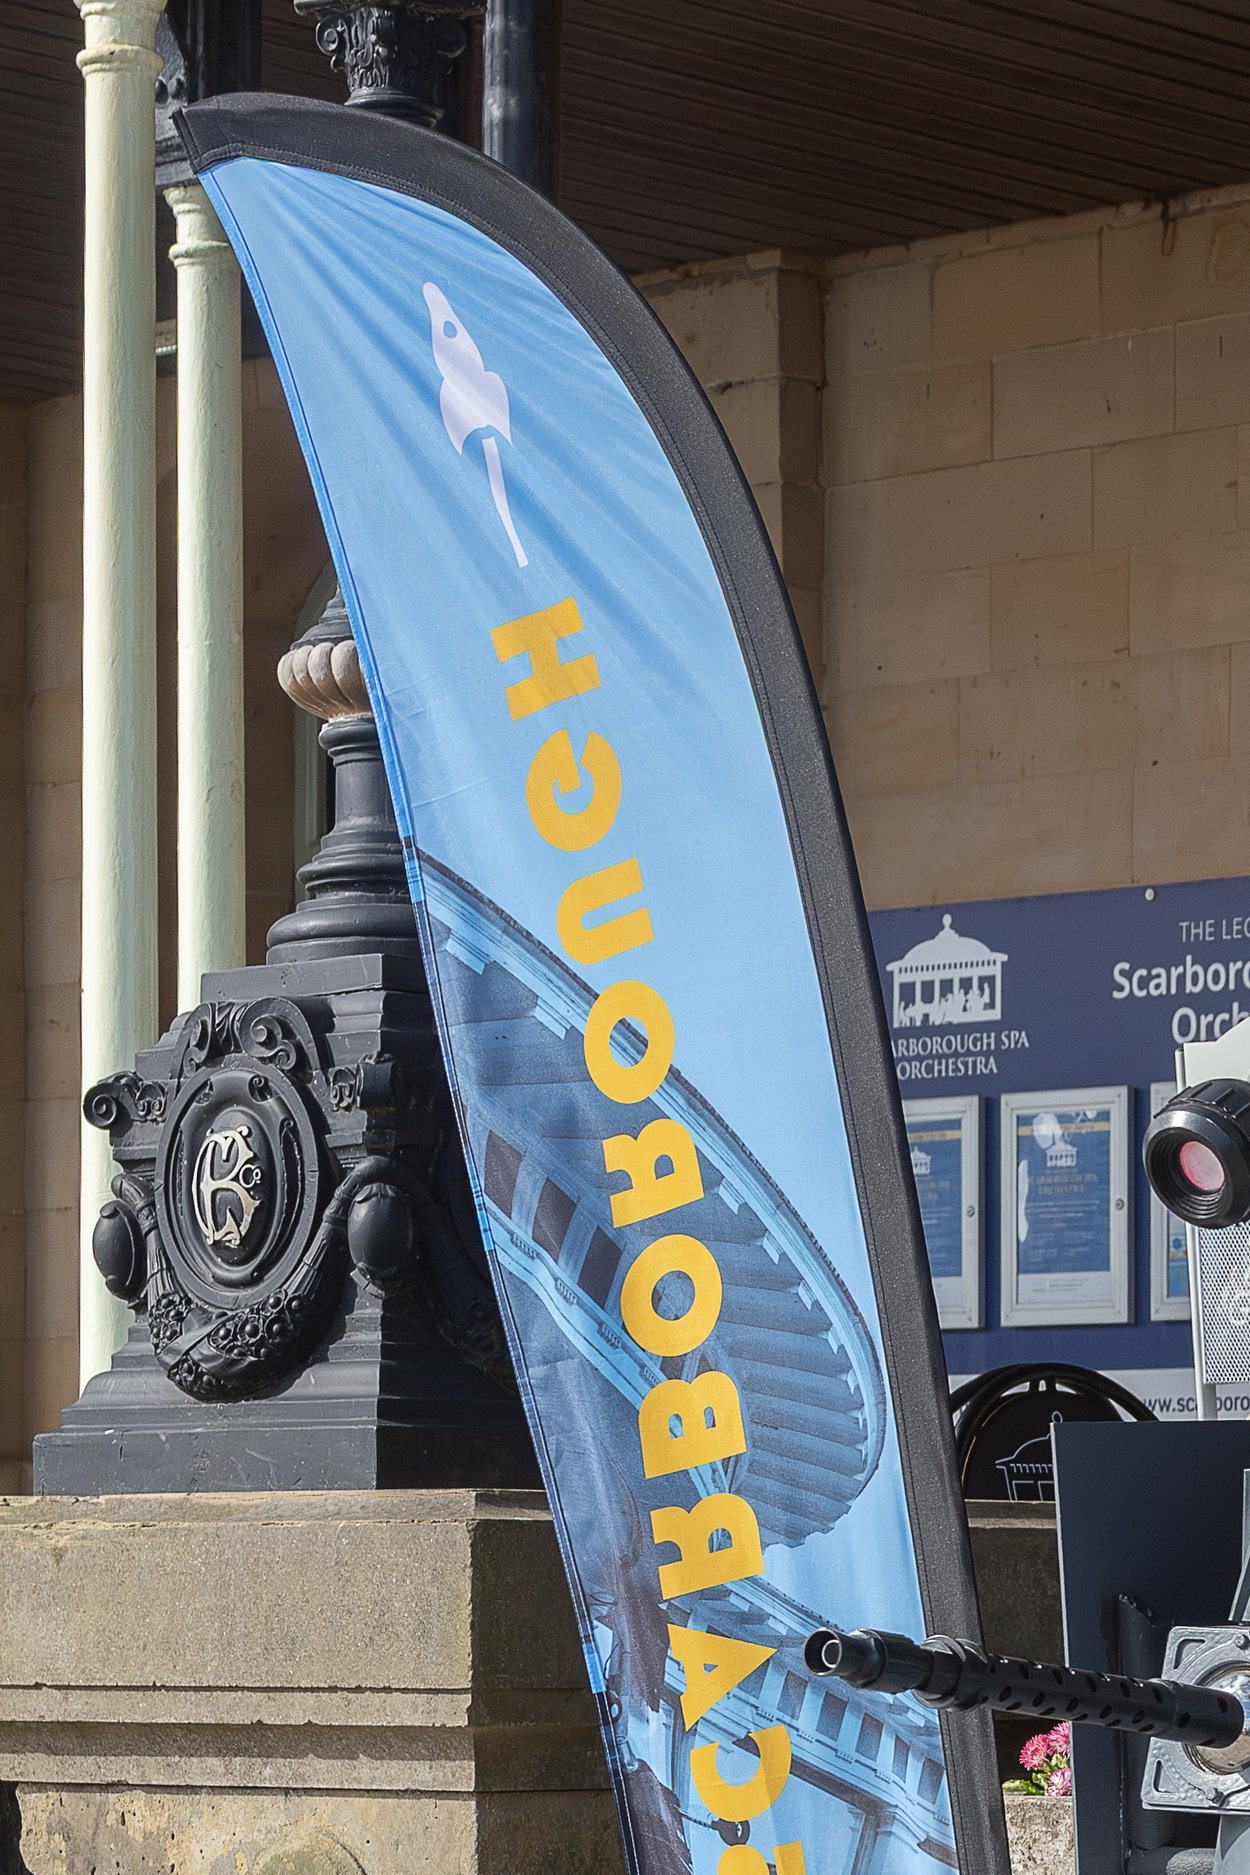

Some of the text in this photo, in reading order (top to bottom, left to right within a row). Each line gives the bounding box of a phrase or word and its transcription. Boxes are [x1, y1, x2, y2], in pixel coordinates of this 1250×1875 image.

[1178, 919, 1216, 943] THE
[891, 1029, 1030, 1058] RBOROUGH SPA
[896, 1055, 998, 1080] ORCHESTRA
